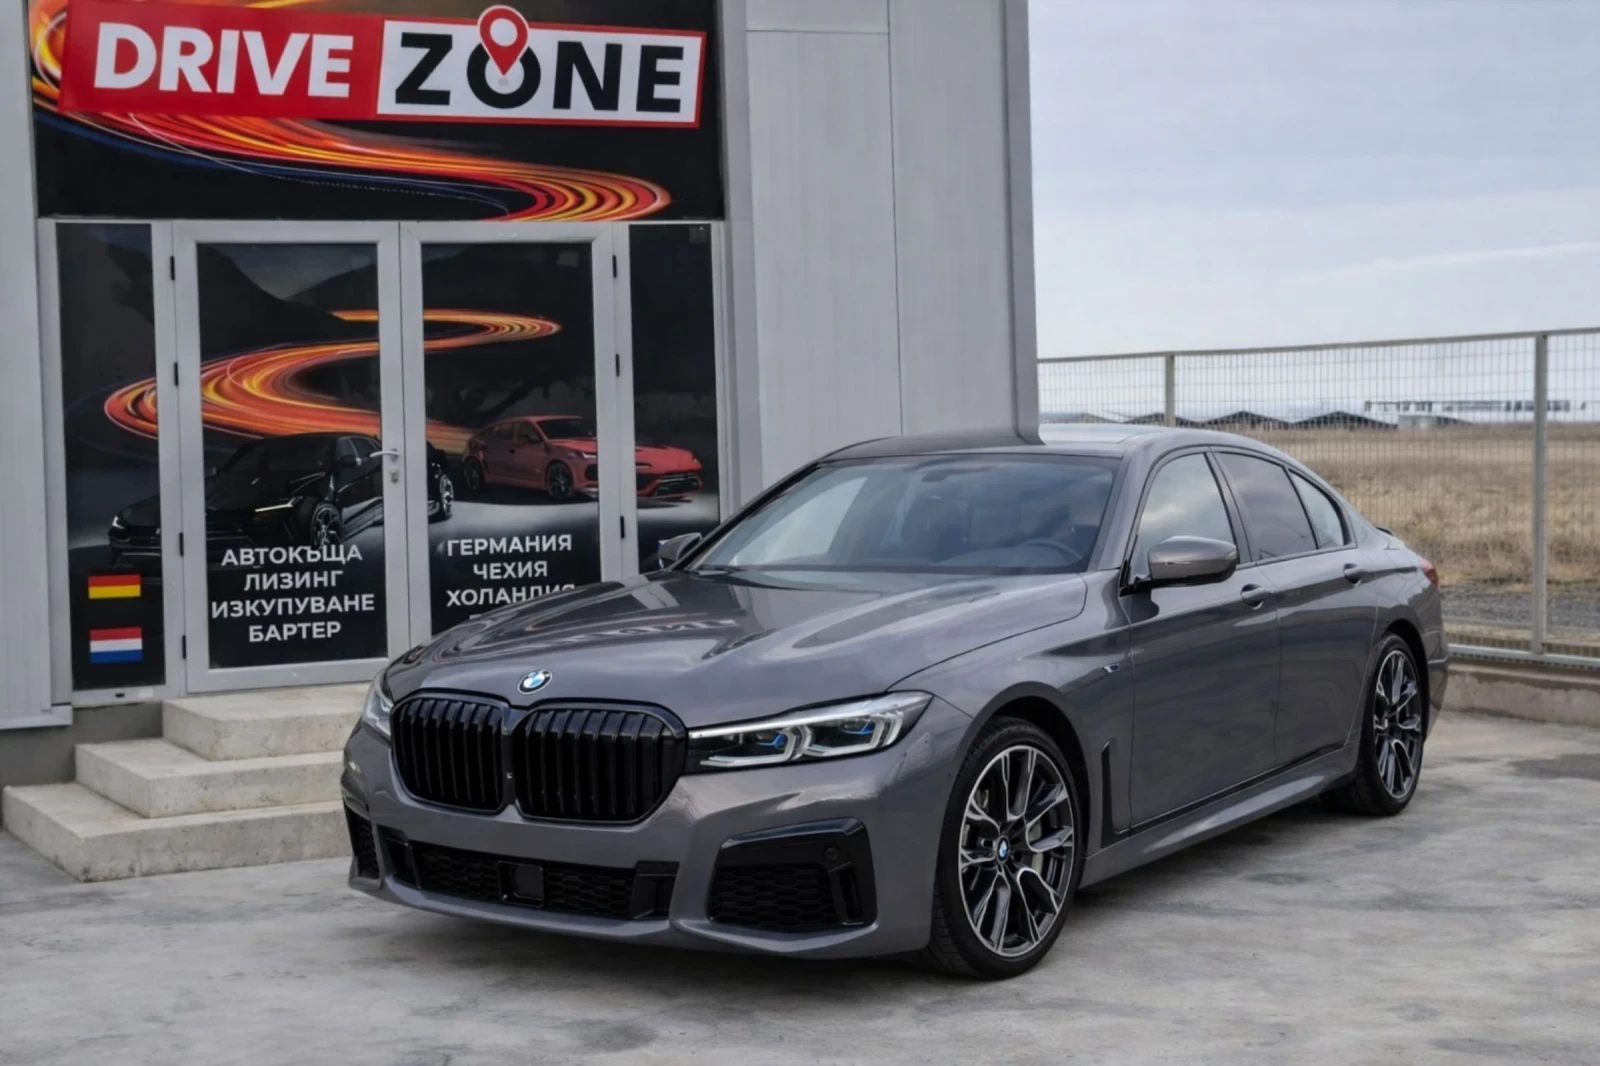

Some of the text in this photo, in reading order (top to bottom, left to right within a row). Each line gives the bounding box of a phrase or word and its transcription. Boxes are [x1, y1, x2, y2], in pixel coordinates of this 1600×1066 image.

[94, 22, 684, 112] DRIVE ZONE
[221, 544, 363, 566] АВТОКЪЩА
[446, 534, 573, 557] ГЕРМАНИЯ
[244, 570, 343, 591] ЛИЗИНГ
[473, 561, 548, 580] ЧЕХИЯ
[212, 593, 375, 619] ИЗКУПУВАНЕ
[249, 620, 341, 642] БАРТЕР
